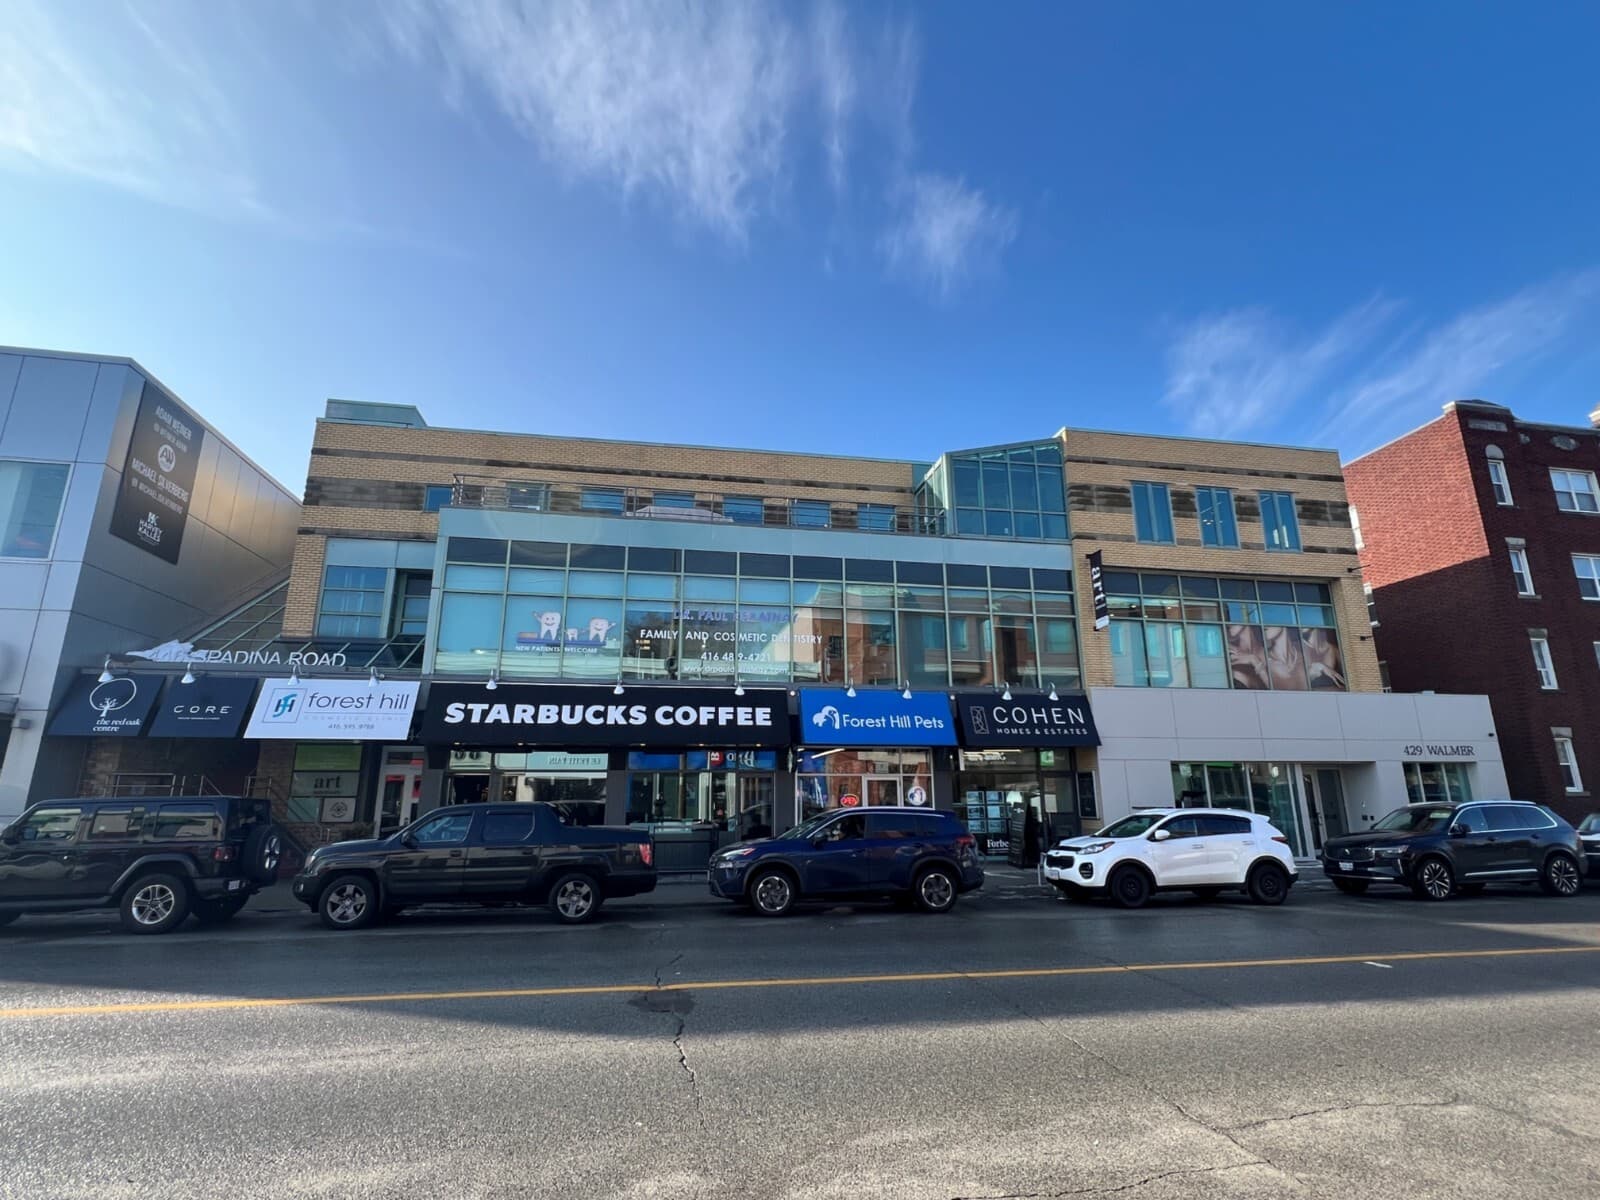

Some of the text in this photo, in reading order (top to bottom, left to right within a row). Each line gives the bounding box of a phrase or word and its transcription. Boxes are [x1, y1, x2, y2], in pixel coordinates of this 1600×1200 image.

[698, 610, 728, 621] PAUL
[640, 629, 822, 645] FAMILY AND COSMETIC DENTISTRY
[289, 651, 346, 666] ROAD
[701, 652, 718, 661] 416
[308, 692, 410, 710] forest hill
[173, 705, 232, 714] CORE
[444, 702, 772, 726] STARBUCKS COFFEE
[993, 706, 1085, 725] COHEN
[96, 717, 111, 726] the
[111, 717, 126, 726] red
[843, 714, 944, 729] Forest Hill Pets
[1403, 744, 1475, 756] 429 WALMER
[314, 776, 341, 789] art
[987, 839, 1009, 848] Forbe
